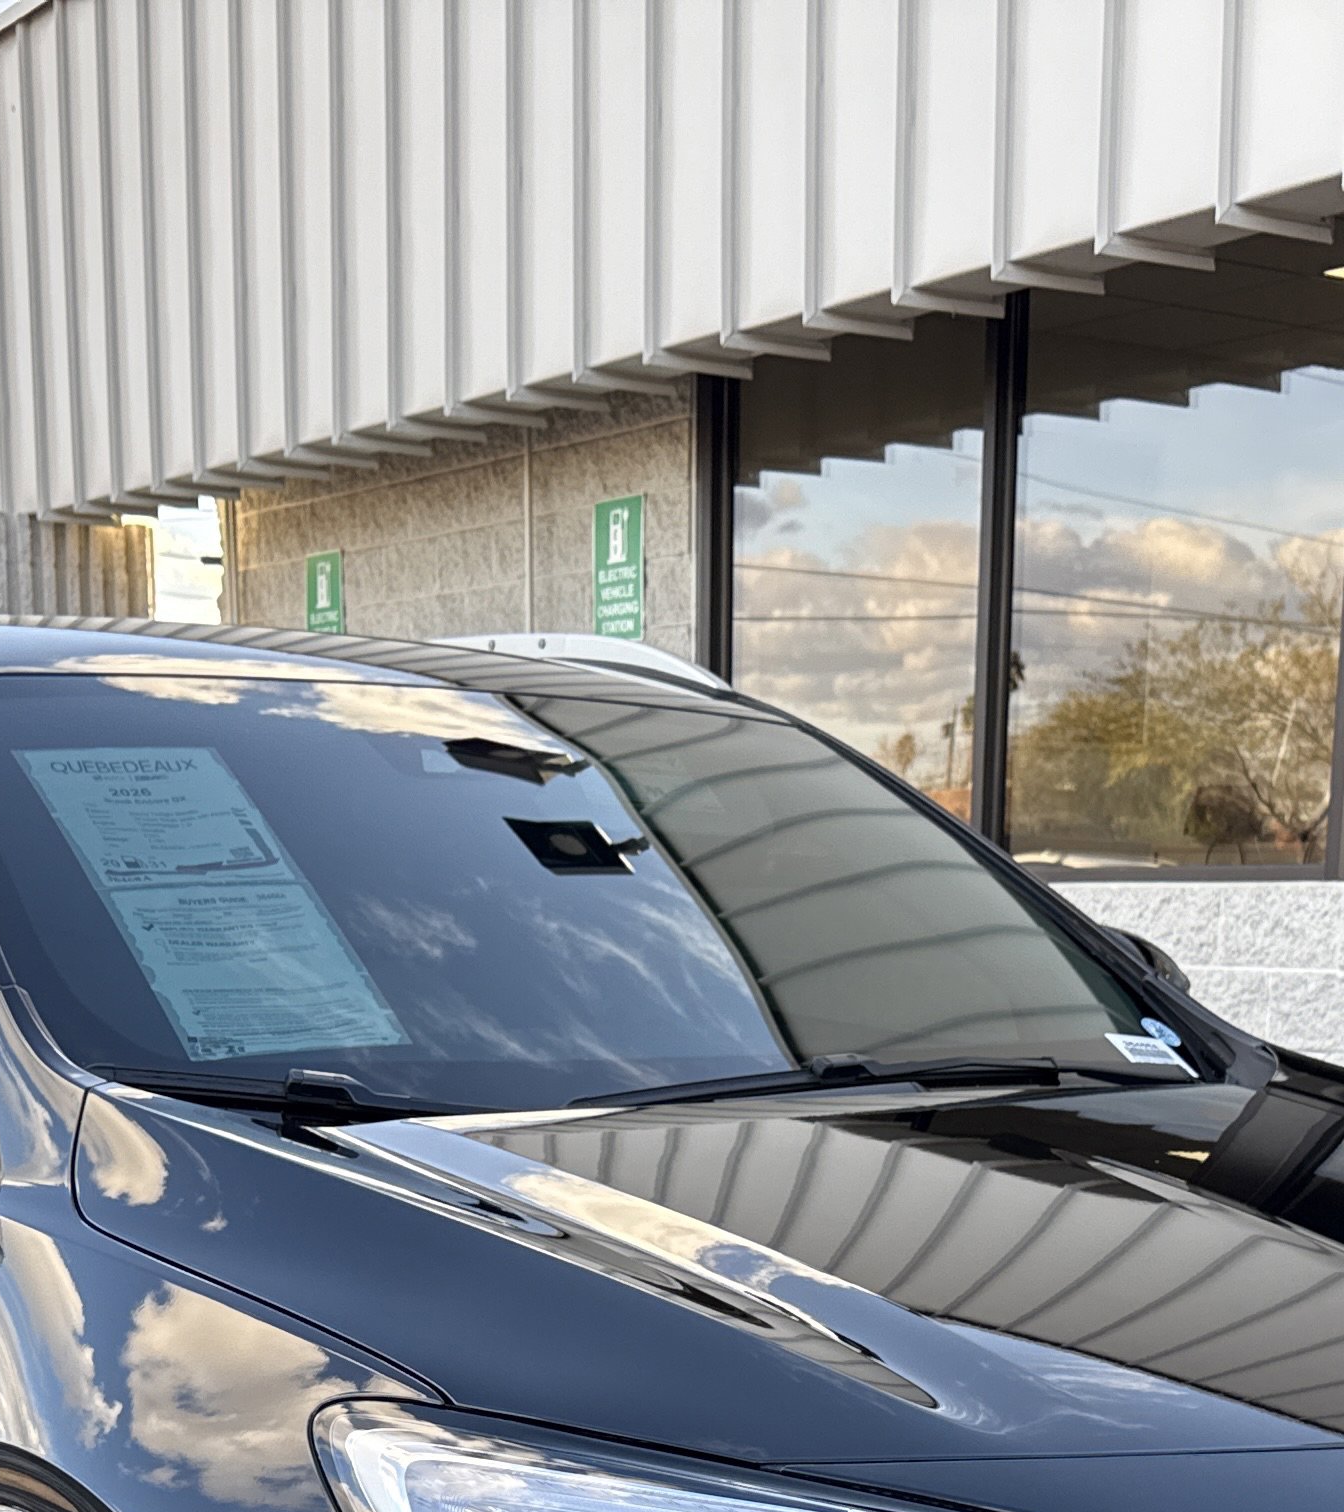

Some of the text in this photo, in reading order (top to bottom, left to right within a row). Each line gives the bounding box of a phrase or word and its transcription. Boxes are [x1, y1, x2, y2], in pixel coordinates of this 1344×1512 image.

[598, 565, 637, 584] ELECTRIC
[50, 759, 197, 775] QUEBEDEAUX
[109, 788, 152, 797] 2026
